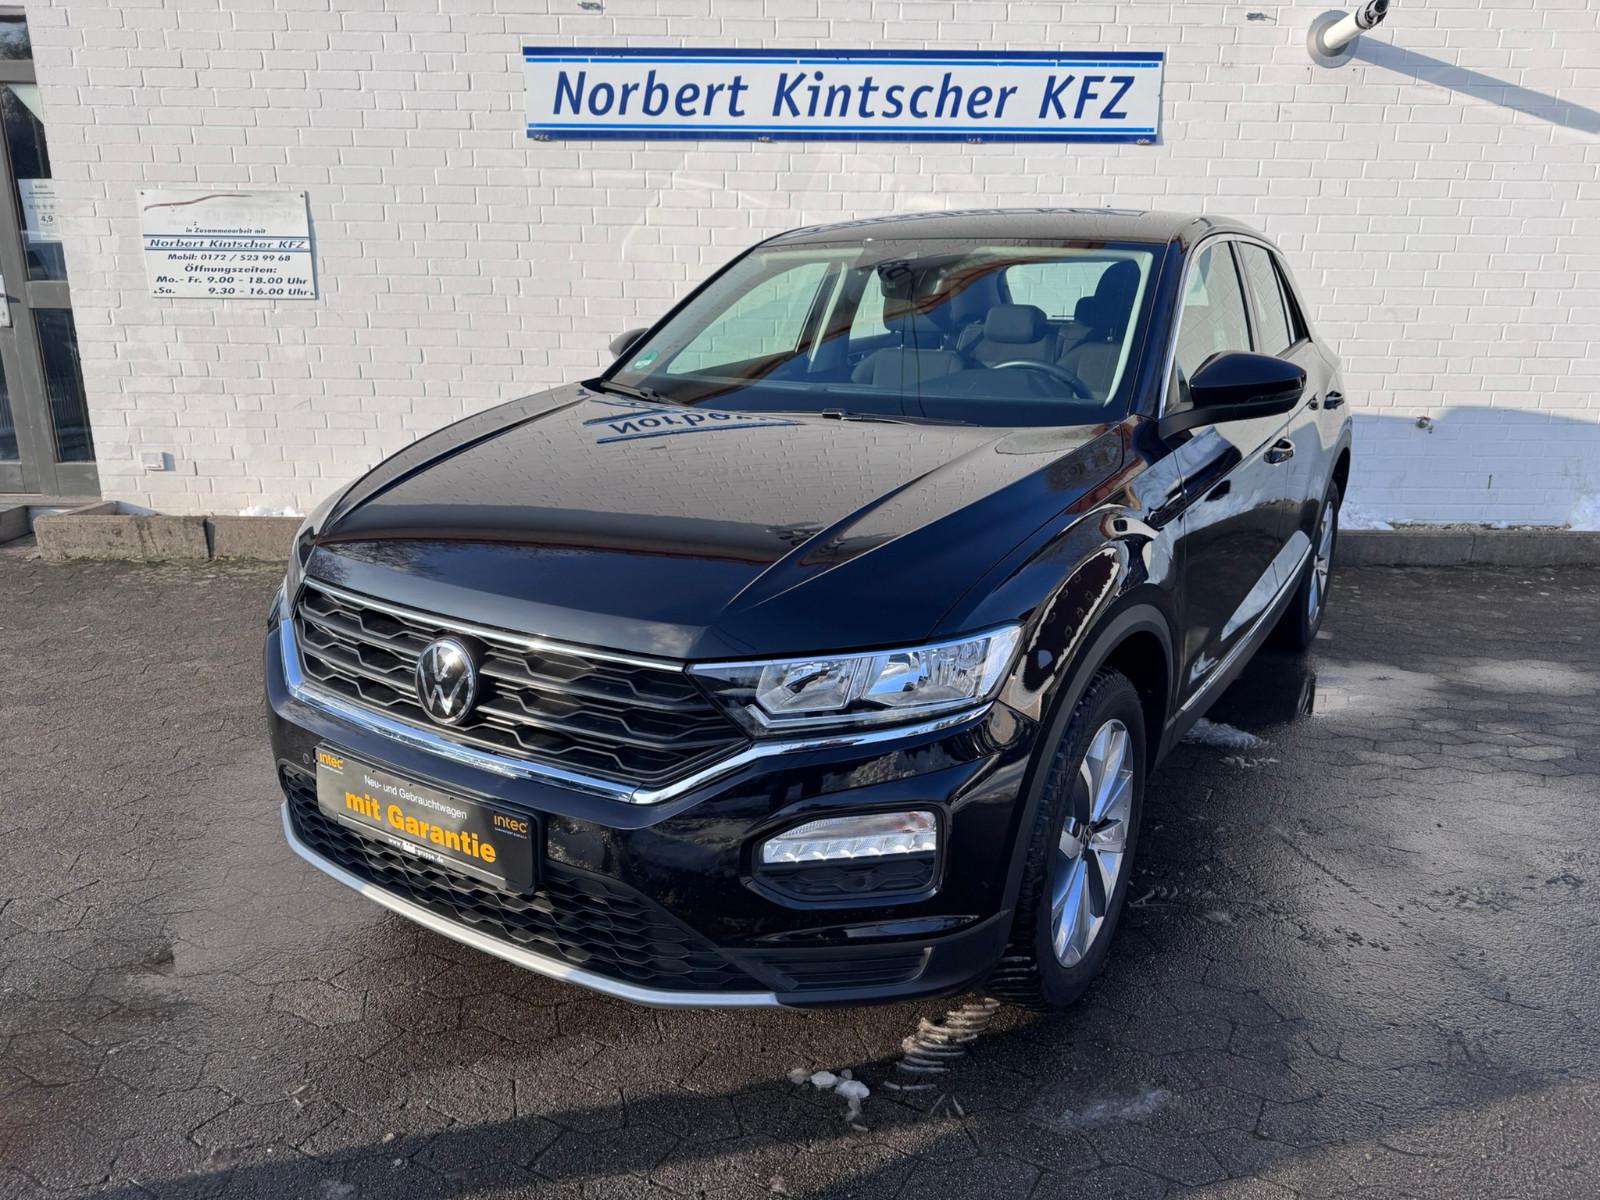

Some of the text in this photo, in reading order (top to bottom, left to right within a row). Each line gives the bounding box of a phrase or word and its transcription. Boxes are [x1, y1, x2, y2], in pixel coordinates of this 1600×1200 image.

[552, 69, 1136, 120] Norbert Kintscher KFZ
[40, 215, 54, 223] 4,9
[150, 239, 205, 247] Norbert
[209, 240, 274, 248] Kintscher
[167, 253, 198, 261] Mobil:
[229, 254, 238, 262] /
[184, 263, 278, 274] Öffnungszeiten:
[319, 752, 344, 769] intec
[364, 774, 468, 820] Neu- und Gebrauchtwagen
[345, 791, 497, 863] mit Garantie
[493, 815, 529, 834] intec
